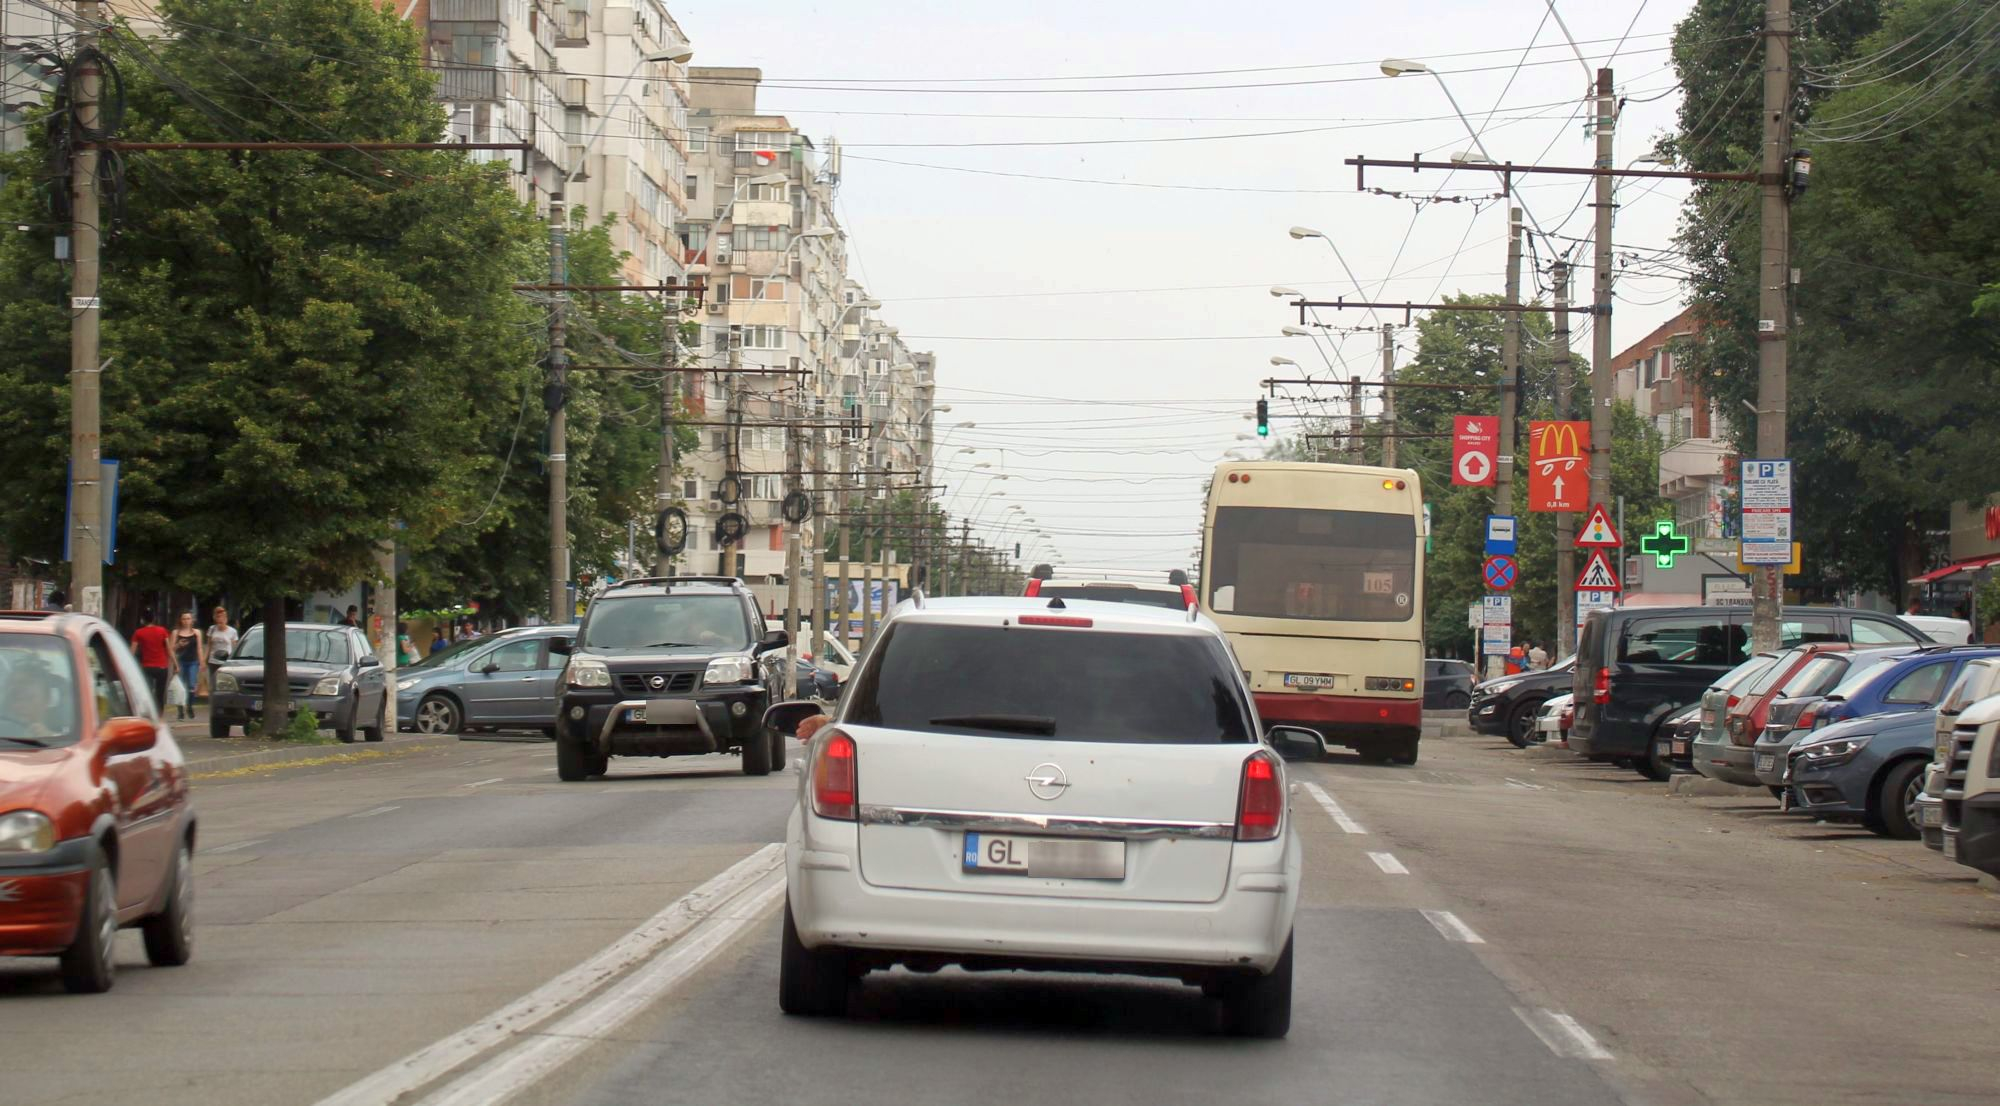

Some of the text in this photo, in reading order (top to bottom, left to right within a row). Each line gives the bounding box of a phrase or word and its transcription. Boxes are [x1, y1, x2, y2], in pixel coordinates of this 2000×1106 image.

[1762, 464, 1772, 476] P
[1366, 579, 1391, 592] 105
[1592, 592, 1600, 601] P
[1303, 676, 1314, 685] 09
[965, 851, 977, 863] RO
[987, 839, 1021, 865] GL
